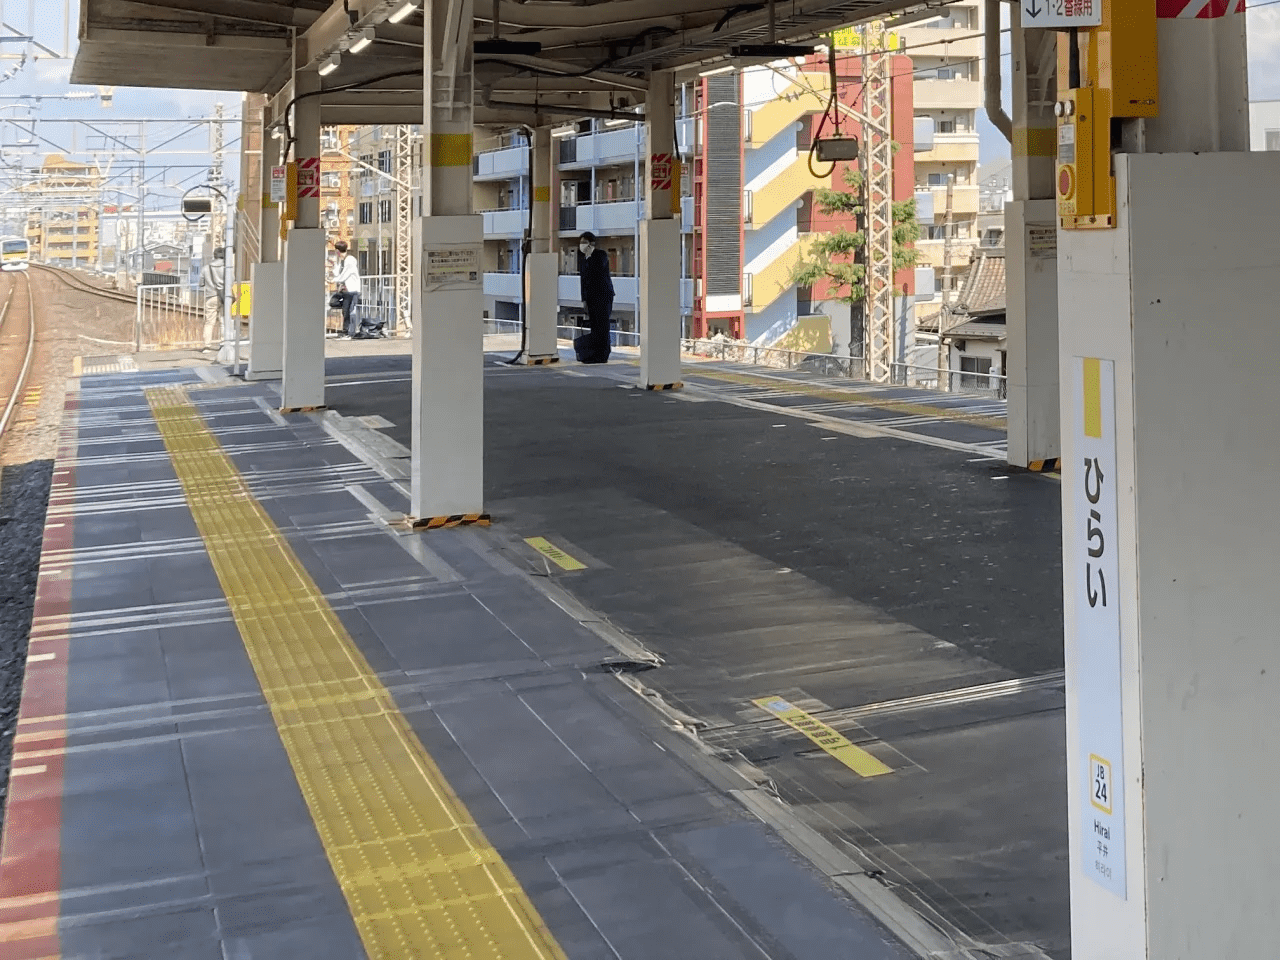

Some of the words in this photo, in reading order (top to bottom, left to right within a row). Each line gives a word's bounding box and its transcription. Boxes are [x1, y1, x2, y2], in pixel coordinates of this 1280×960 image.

[1084, 456, 1107, 609] ひらい
[1096, 763, 1105, 780] JB
[1095, 779, 1107, 803] 24
[1093, 819, 1111, 841] Hirai
[1096, 840, 1109, 858] 平井
